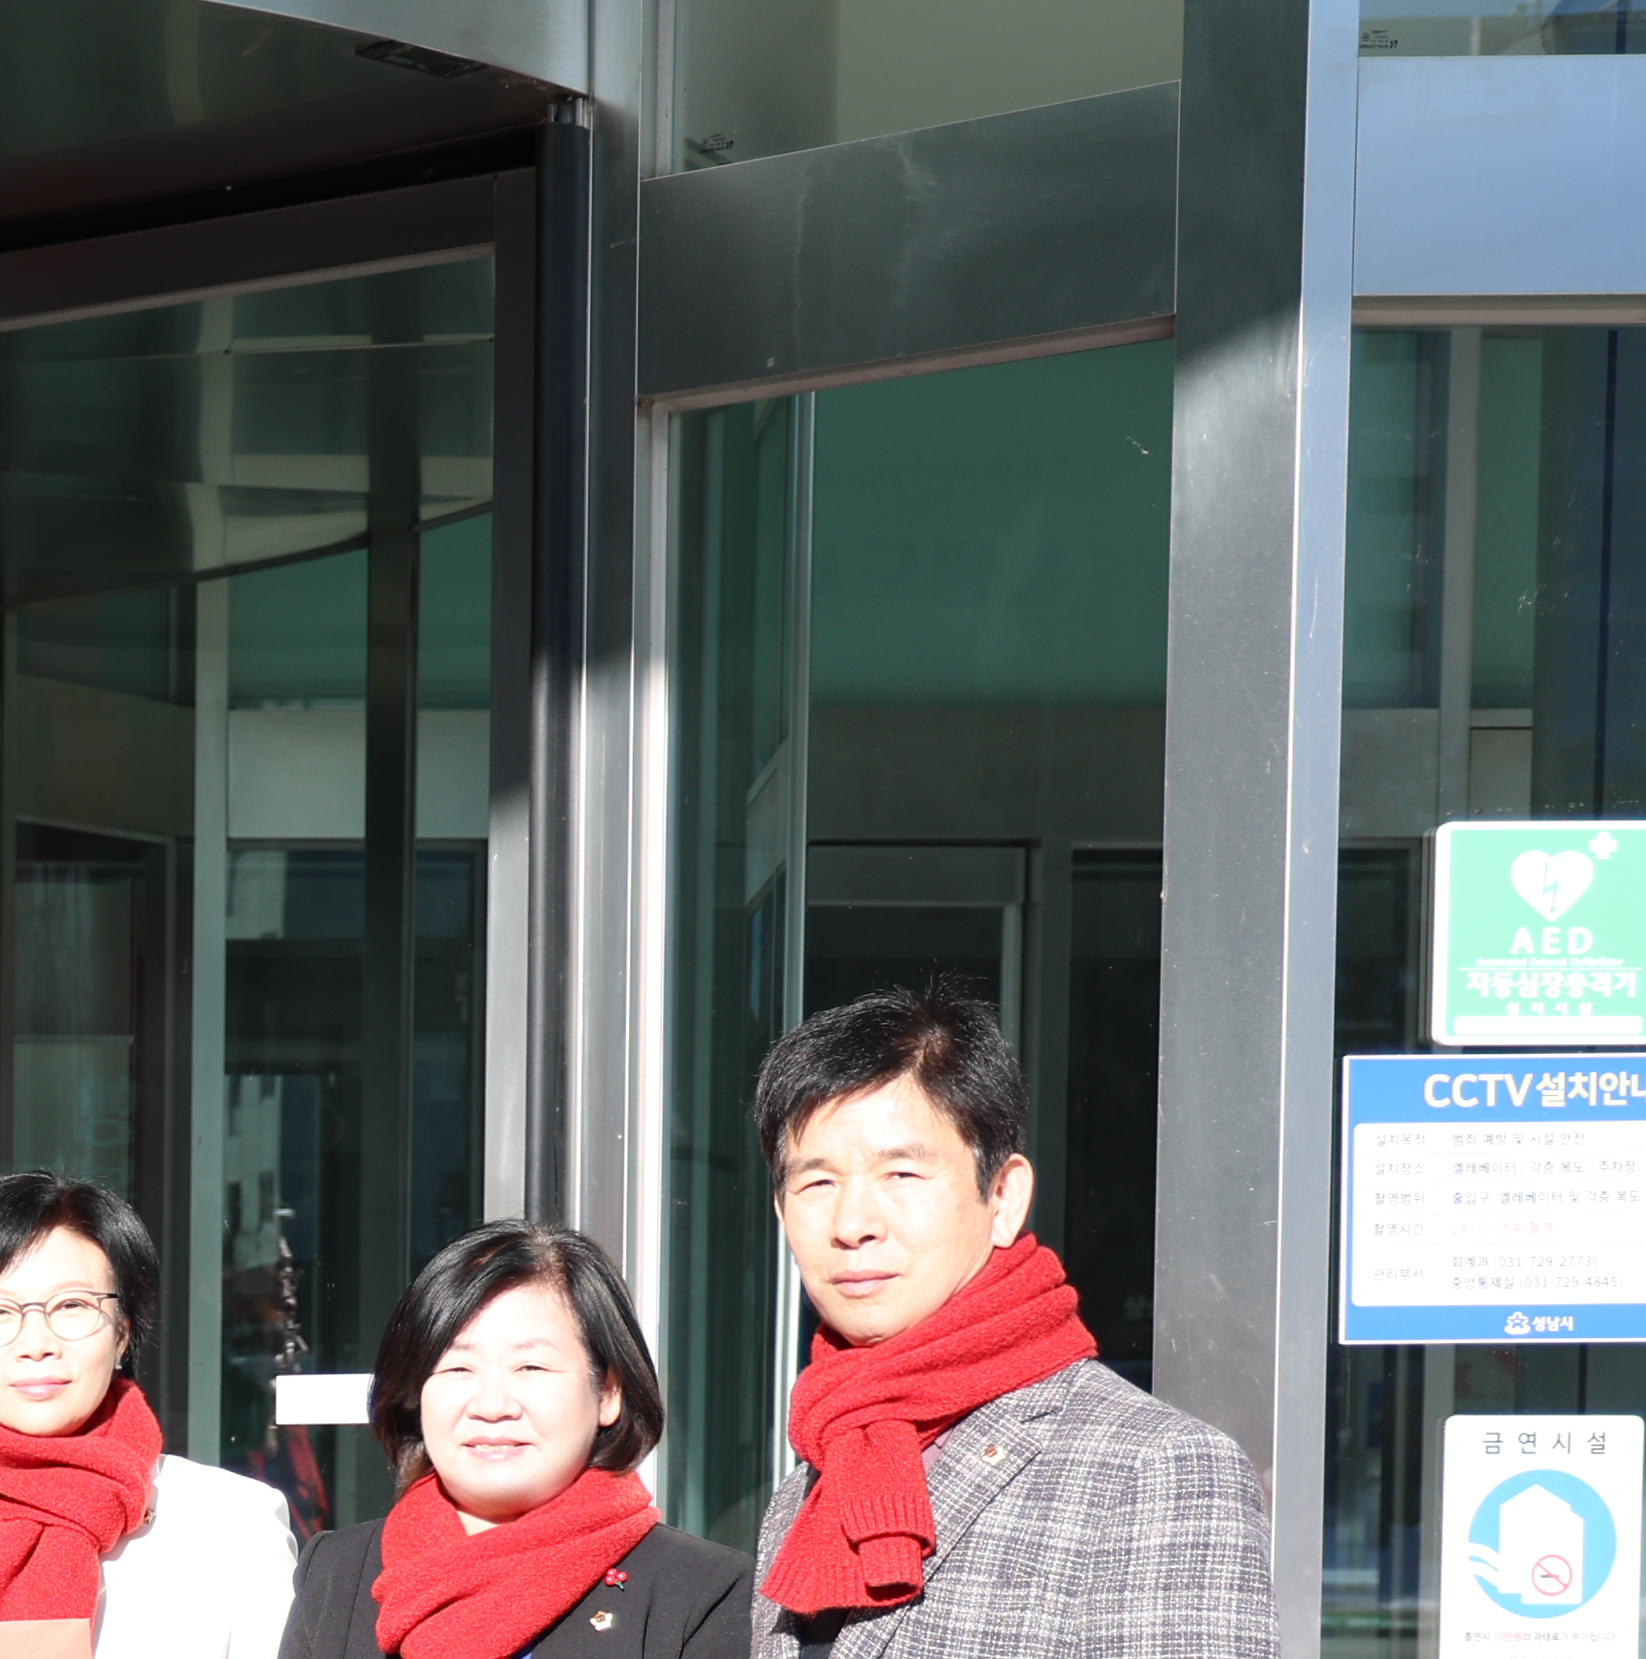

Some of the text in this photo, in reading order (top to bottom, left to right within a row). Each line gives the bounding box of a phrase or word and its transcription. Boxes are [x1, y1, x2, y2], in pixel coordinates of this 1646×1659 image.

[1510, 926, 1593, 955] AED
[1465, 971, 1637, 999] 자동심장충격기
[1375, 1132, 1586, 1147] 설치목적 범죄 예방 및 시설 안전
[1374, 1163, 1425, 1176] 설치장소
[1530, 1160, 1555, 1175] 각층
[1560, 1160, 1585, 1174] 복도
[1598, 1160, 1637, 1174] 주차장
[1374, 1192, 1425, 1206] 촬영범위
[1569, 1190, 1580, 1204] 및
[1586, 1190, 1610, 1204] 각층
[1616, 1190, 1641, 1203] 복도
[1374, 1222, 1425, 1237] 촬영시간
[1452, 1222, 1493, 1235] 24시간
[1499, 1221, 1523, 1235] 연속
[1451, 1255, 1598, 1269] 회계과 (031-729-2773)
[1374, 1268, 1425, 1282] 관리부서
[1451, 1275, 1624, 1291] 중앙통제실 (031-729-4845)
[1531, 1314, 1575, 1332] 성남시
[1482, 1431, 1607, 1456] 금연시설
